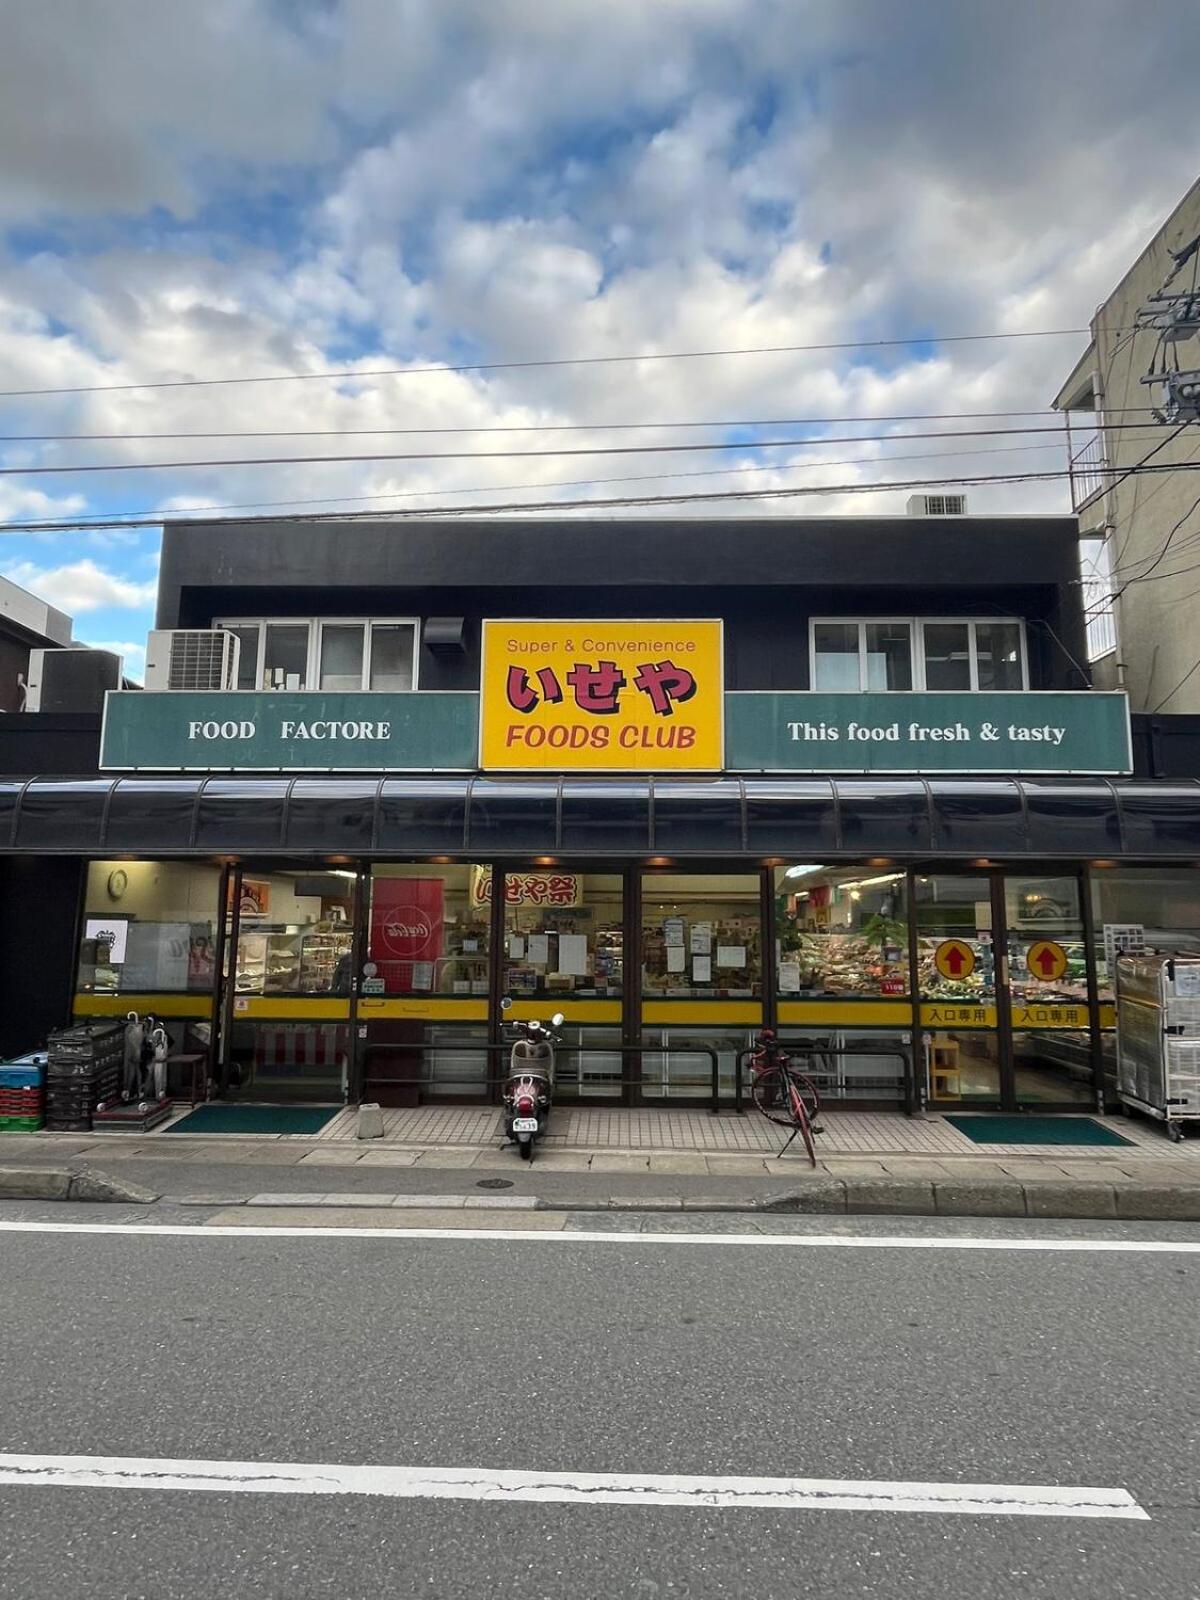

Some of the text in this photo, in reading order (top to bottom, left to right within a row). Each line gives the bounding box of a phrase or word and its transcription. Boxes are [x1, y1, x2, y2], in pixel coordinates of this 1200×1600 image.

[507, 639, 696, 654] Super & Convenience
[507, 660, 697, 716] いせや
[188, 721, 391, 739] FOOD FACTORE
[506, 725, 697, 748] FOODS CLUB
[787, 722, 1066, 745] This food fresh & tasty
[929, 1009, 986, 1023] 入口専用
[1021, 1009, 1079, 1023] 入口専用
